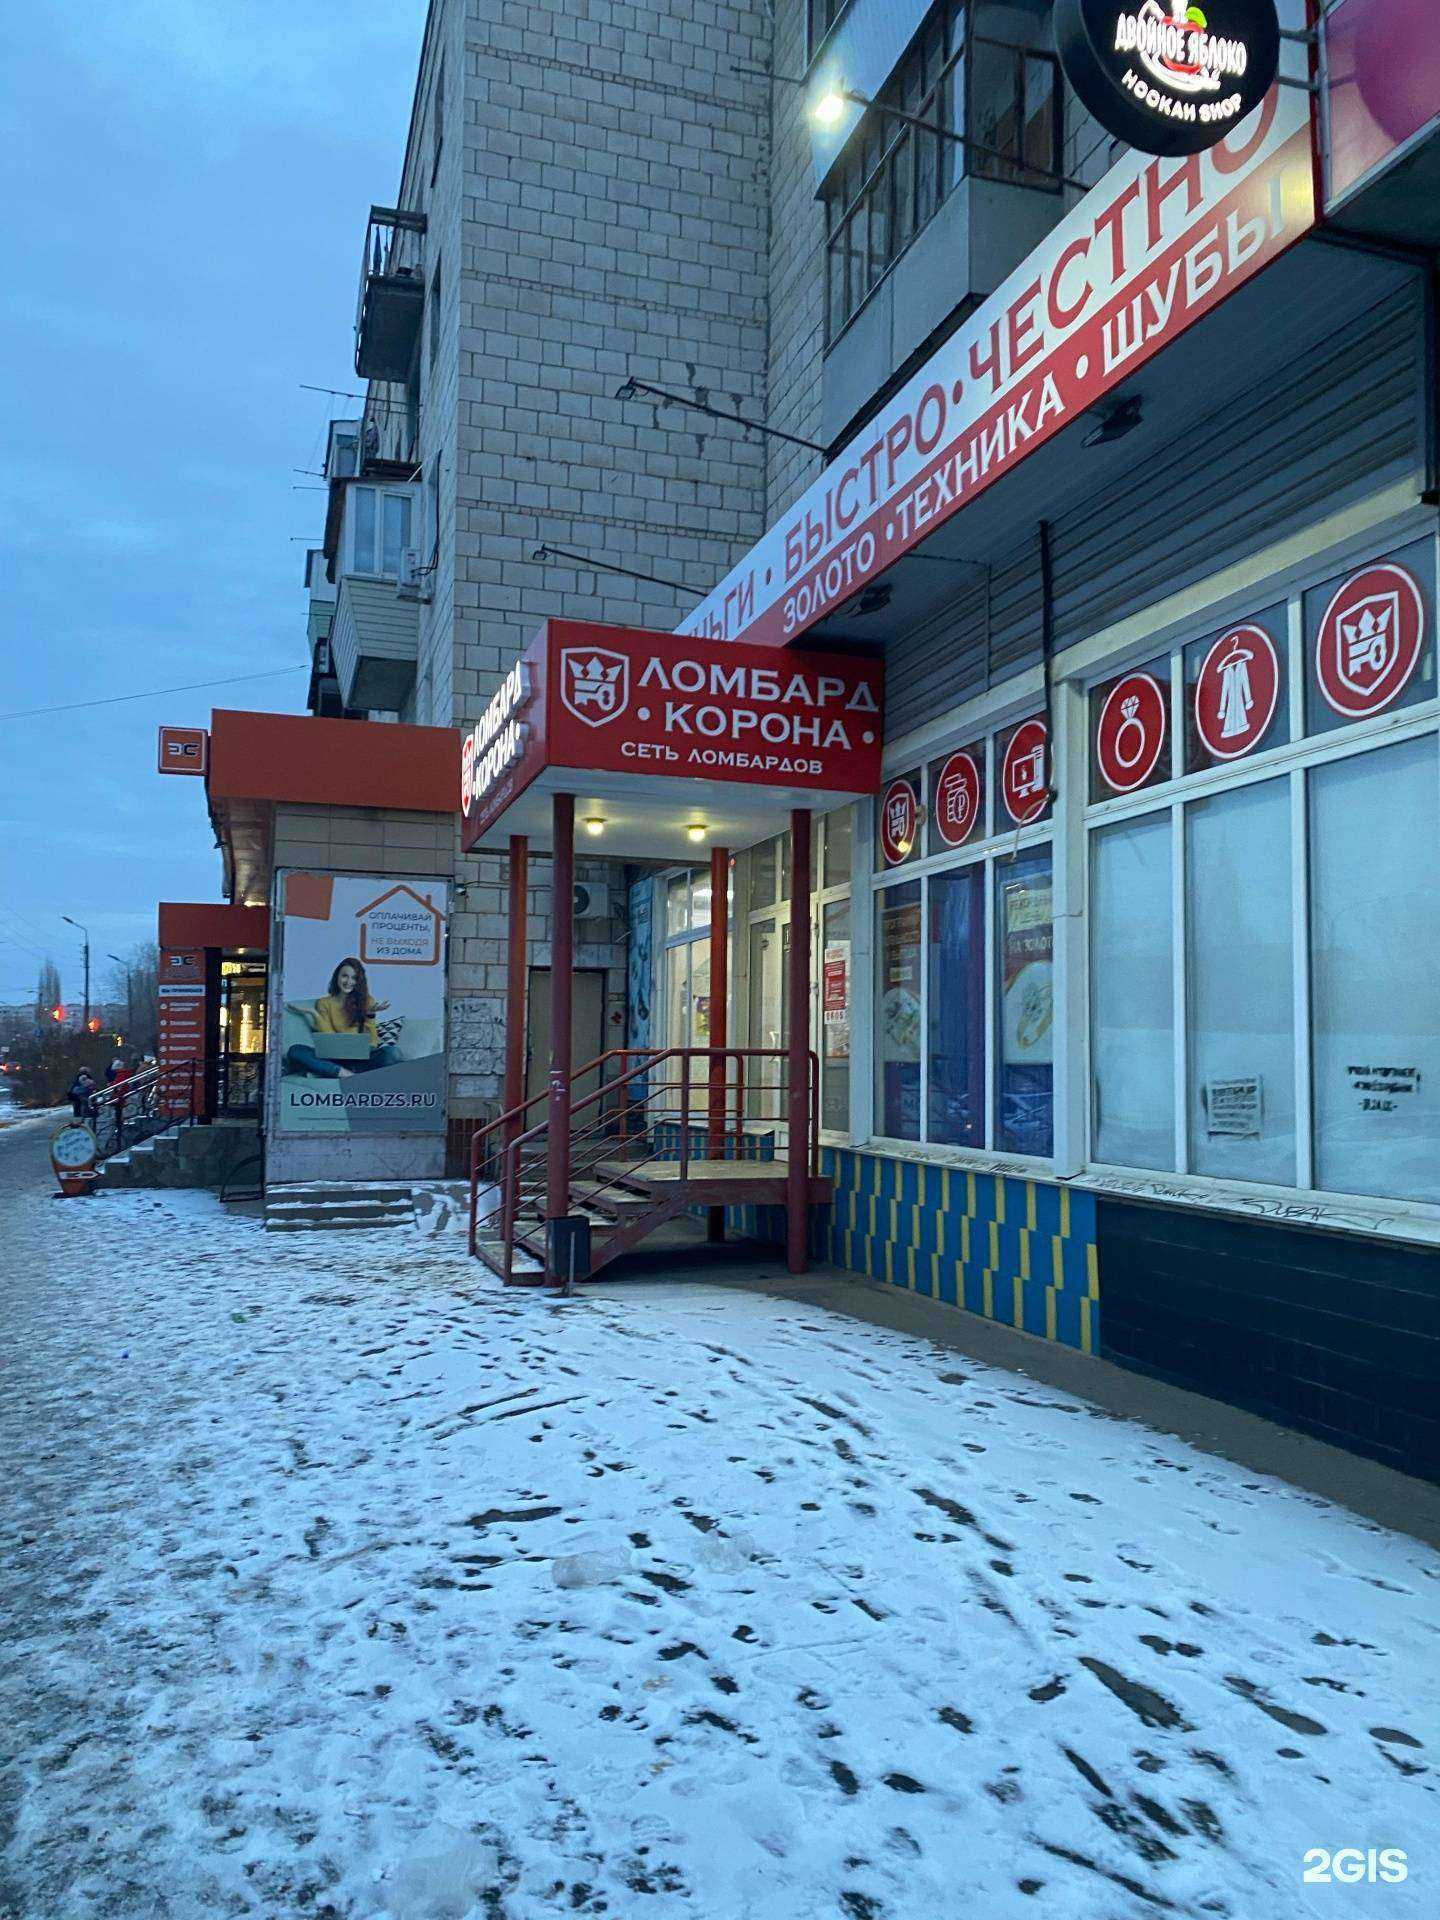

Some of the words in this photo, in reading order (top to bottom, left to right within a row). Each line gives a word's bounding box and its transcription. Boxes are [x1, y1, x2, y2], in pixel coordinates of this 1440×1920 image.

[1114, 12, 1186, 62] ДВОЙНОЕ
[1187, 31, 1248, 77] ЯБЛОКО
[1121, 68, 1196, 121] HOOKAH
[1198, 92, 1242, 122] SHOP
[782, 531, 875, 634] ЗОЛОТО
[896, 371, 1066, 541] ТЕХНИКА
[1102, 169, 1286, 378] ШУБЫ
[784, 382, 947, 584] БЫСТРО
[473, 660, 522, 761] ЛОМБАРД
[637, 657, 880, 713] ЛОМБАРД
[663, 701, 852, 750] КОРОНА
[475, 719, 516, 801] КОРОНА
[620, 741, 679, 761] СЕТЬ
[688, 748, 823, 775] ЛОМБАРДОВ
[368, 911, 432, 921] ОПЛАЧИВАЙ
[376, 946, 390, 954] ИЗ
[391, 947, 422, 956] ДОМА
[290, 1092, 436, 1108] LOMBARDZS.RU
